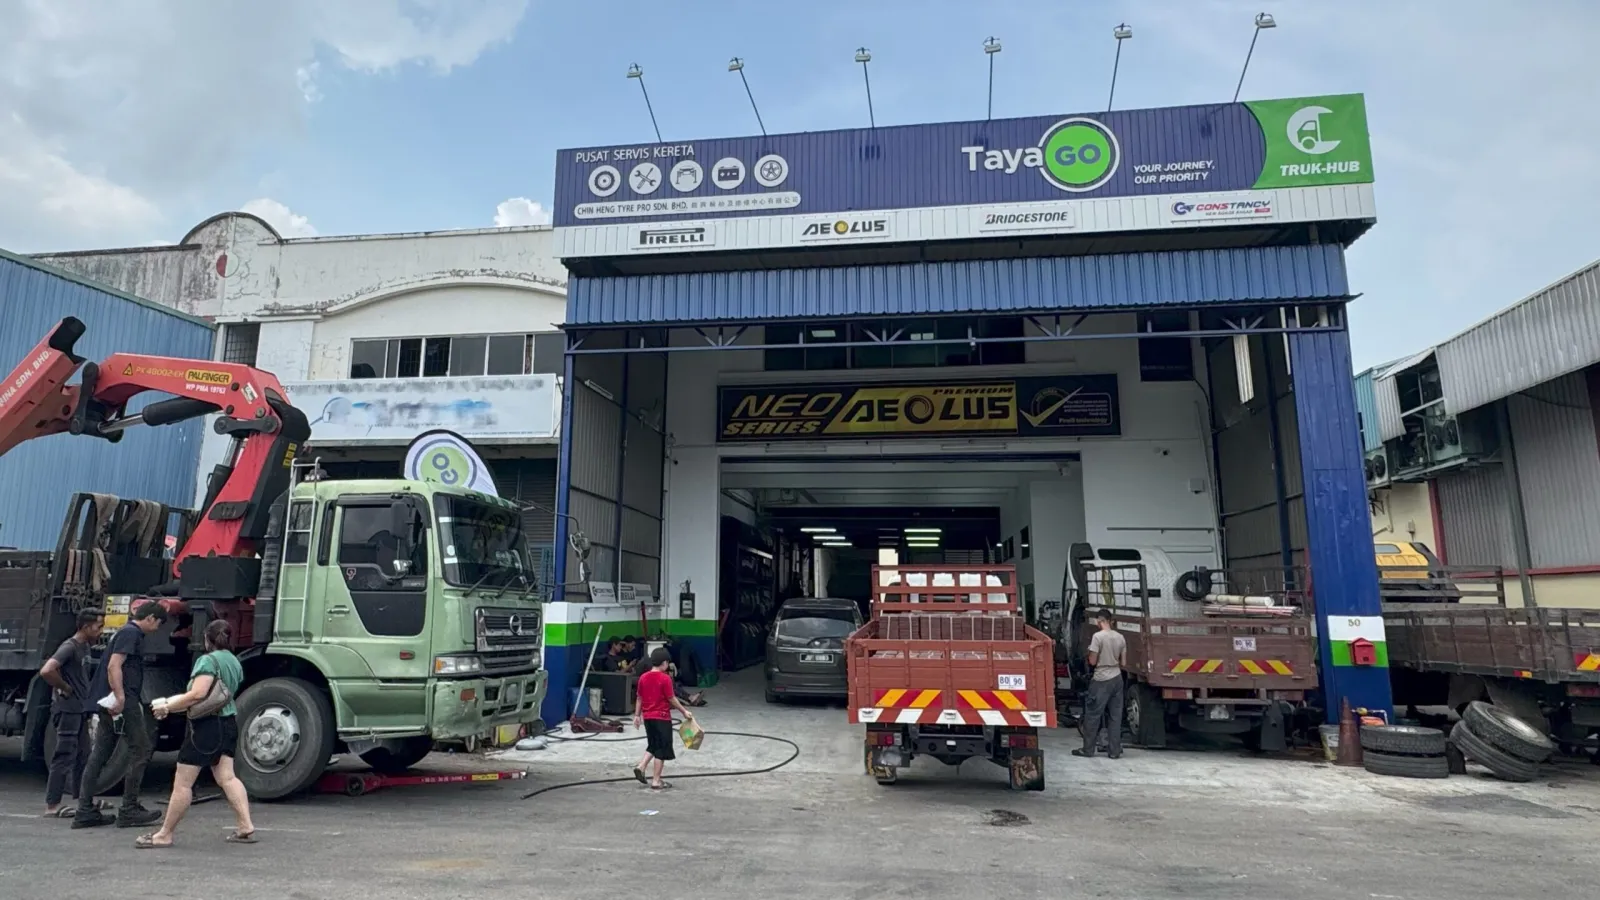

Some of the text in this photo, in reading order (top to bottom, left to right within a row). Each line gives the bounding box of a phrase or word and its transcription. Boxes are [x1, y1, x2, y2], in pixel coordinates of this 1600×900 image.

[575, 144, 695, 163] PUSAT SERVIS KERETA
[961, 144, 1101, 174] Taya GO
[1133, 160, 1215, 173] YOUR JOURNEY,
[1280, 161, 1360, 176] TRUK-HUB
[1134, 172, 1209, 184] OUR PRIORITY
[577, 201, 688, 216] CHIN HENG TYRE PRO SDN. BHD.
[1196, 200, 1271, 212] CONSTANCY
[984, 211, 1068, 225] BRIDGESTONE
[802, 219, 887, 237] AEOLUS
[639, 227, 706, 245] PIRELLI
[15, 368, 34, 388] SDN.
[32, 350, 52, 370] BHD.
[187, 371, 230, 384] PALFINGER
[933, 387, 1013, 396] PREMIUM
[732, 393, 842, 418] NEO
[841, 394, 1014, 425] AEOLUS
[723, 419, 822, 436] SERIES
[999, 675, 1023, 686] 80 90
